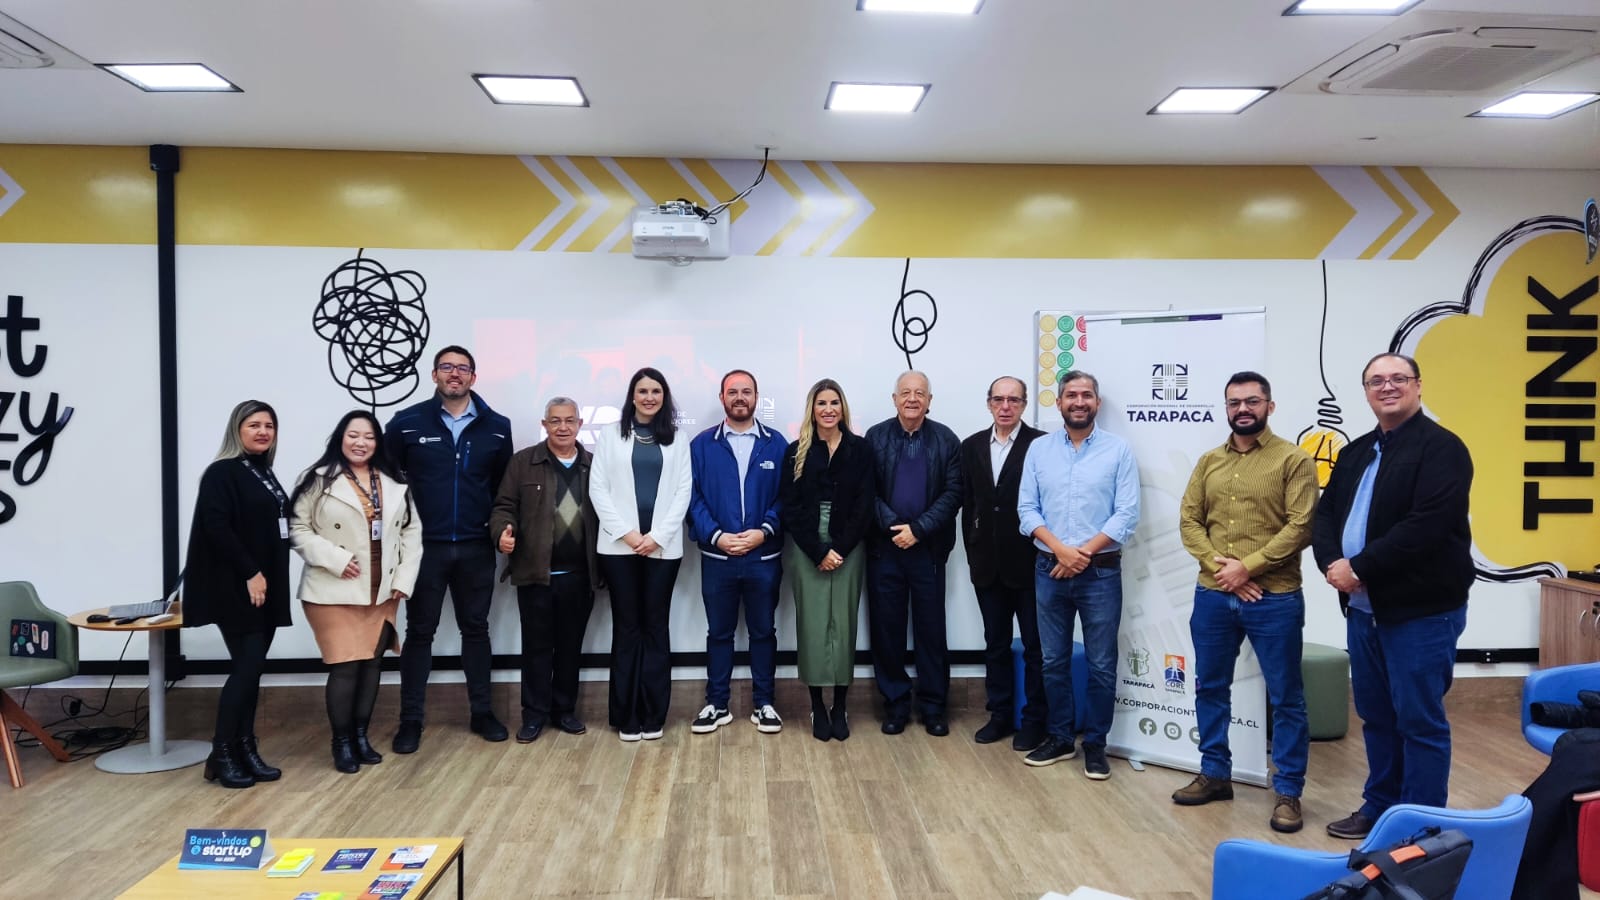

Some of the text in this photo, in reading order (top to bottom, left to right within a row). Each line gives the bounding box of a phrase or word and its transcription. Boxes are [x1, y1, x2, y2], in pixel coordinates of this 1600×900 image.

[0, 295, 48, 377] t
[1523, 275, 1599, 530] THINK
[1165, 680, 1185, 690] CORE
[189, 835, 248, 846] Bem-vindos
[202, 845, 253, 858] startup
